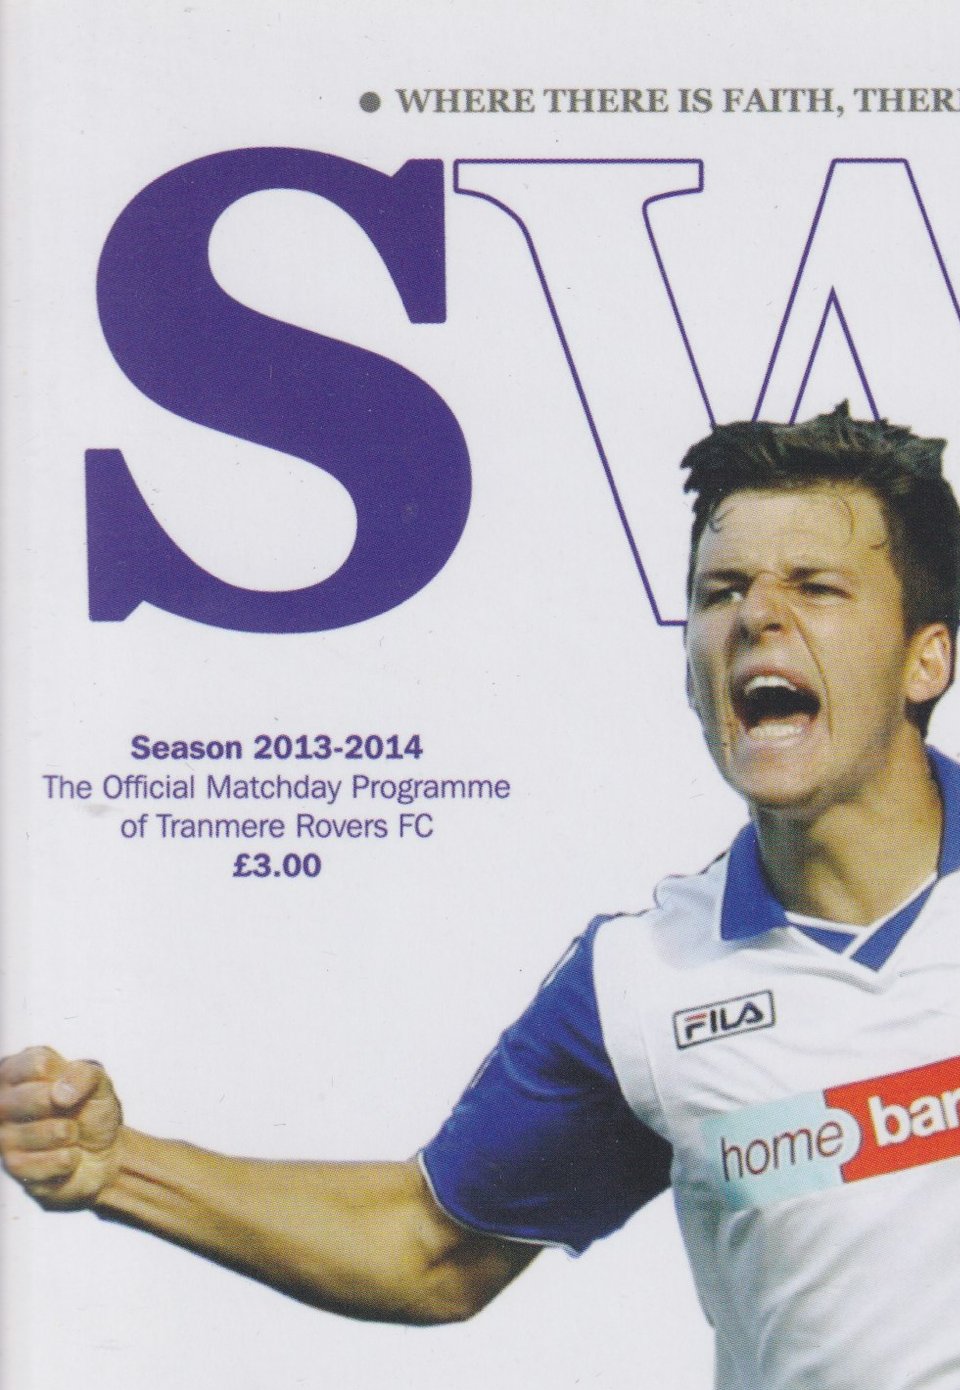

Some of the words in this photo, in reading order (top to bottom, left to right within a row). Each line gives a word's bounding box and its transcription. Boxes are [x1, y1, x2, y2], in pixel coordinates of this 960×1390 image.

[395, 88, 535, 113] WHERE
[543, 88, 669, 113] THERE
[679, 88, 713, 113] IS
[723, 88, 844, 118] FAITH,
[131, 735, 242, 760] Season
[254, 734, 423, 760] 2013-2014
[43, 775, 92, 799] The
[103, 774, 194, 799] Official
[207, 774, 342, 805] Matchday
[353, 774, 510, 805] Programme
[121, 813, 148, 838] of
[156, 814, 285, 838] Tranmere
[297, 813, 388, 838] Rovers
[400, 813, 433, 838] FC
[232, 853, 321, 878] £3.00
[684, 1002, 763, 1041] FILA
[720, 1118, 844, 1182] home
